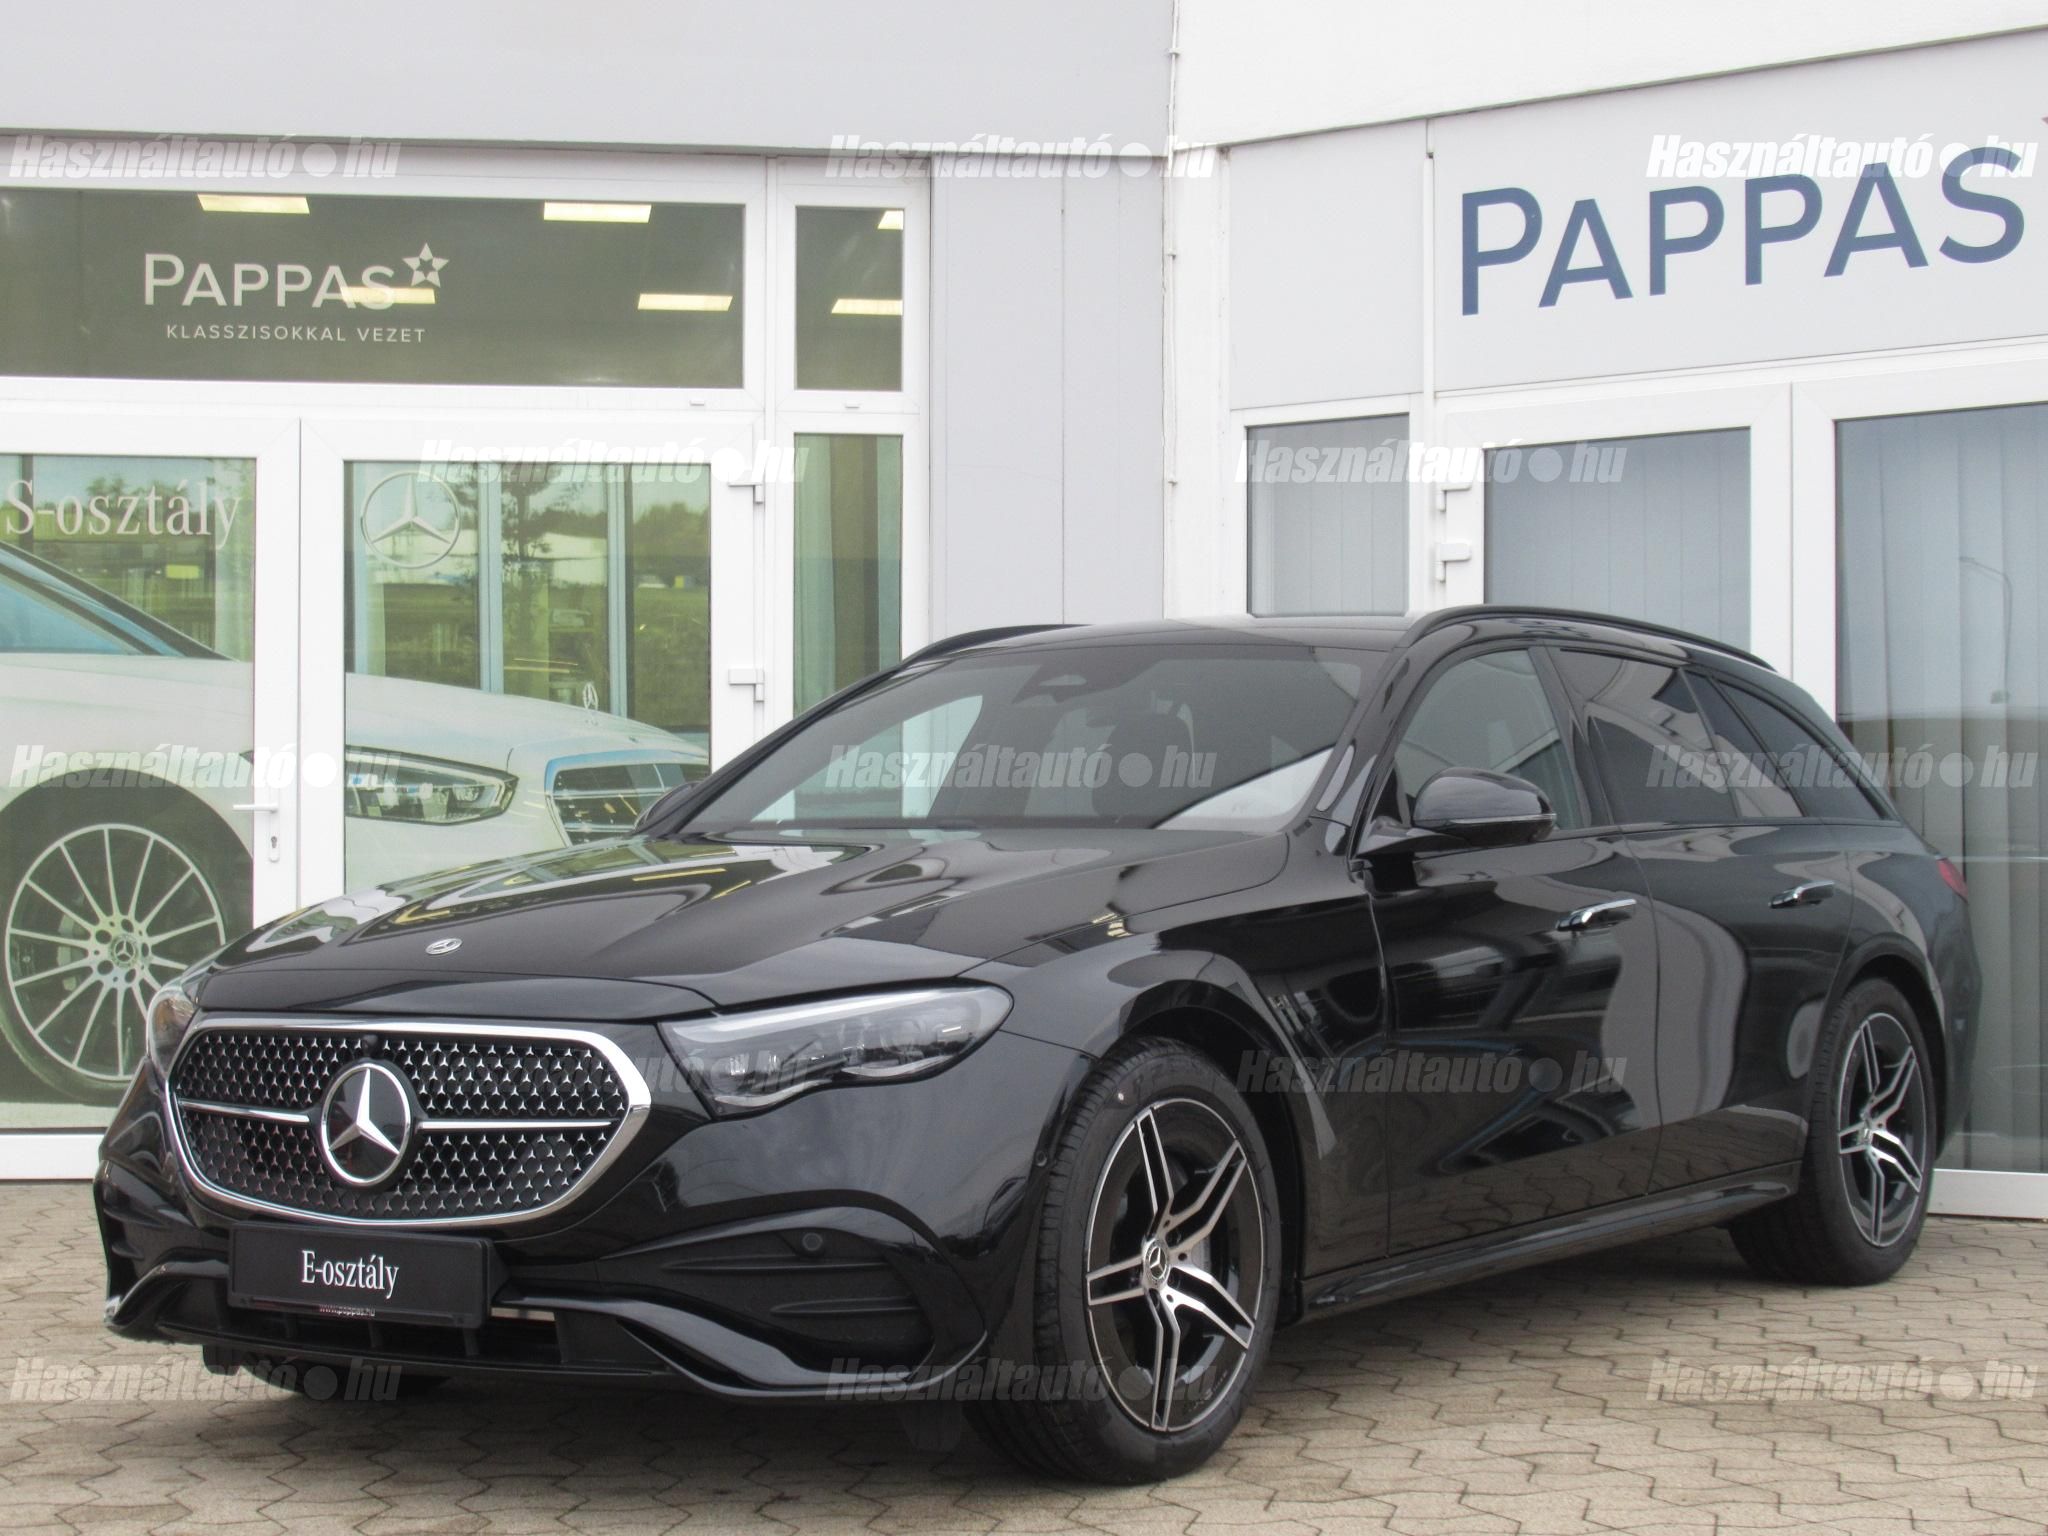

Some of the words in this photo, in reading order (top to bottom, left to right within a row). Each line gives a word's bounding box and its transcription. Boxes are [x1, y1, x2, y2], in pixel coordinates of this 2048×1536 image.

[1462, 147, 2025, 316] PAPPAS
[144, 252, 395, 309] PAPPAS
[167, 324, 346, 342] KLASSZISOKKAL
[356, 328, 426, 343] VEZET
[5, 480, 241, 550] S-osztály
[302, 1249, 399, 1300] E-osztály
